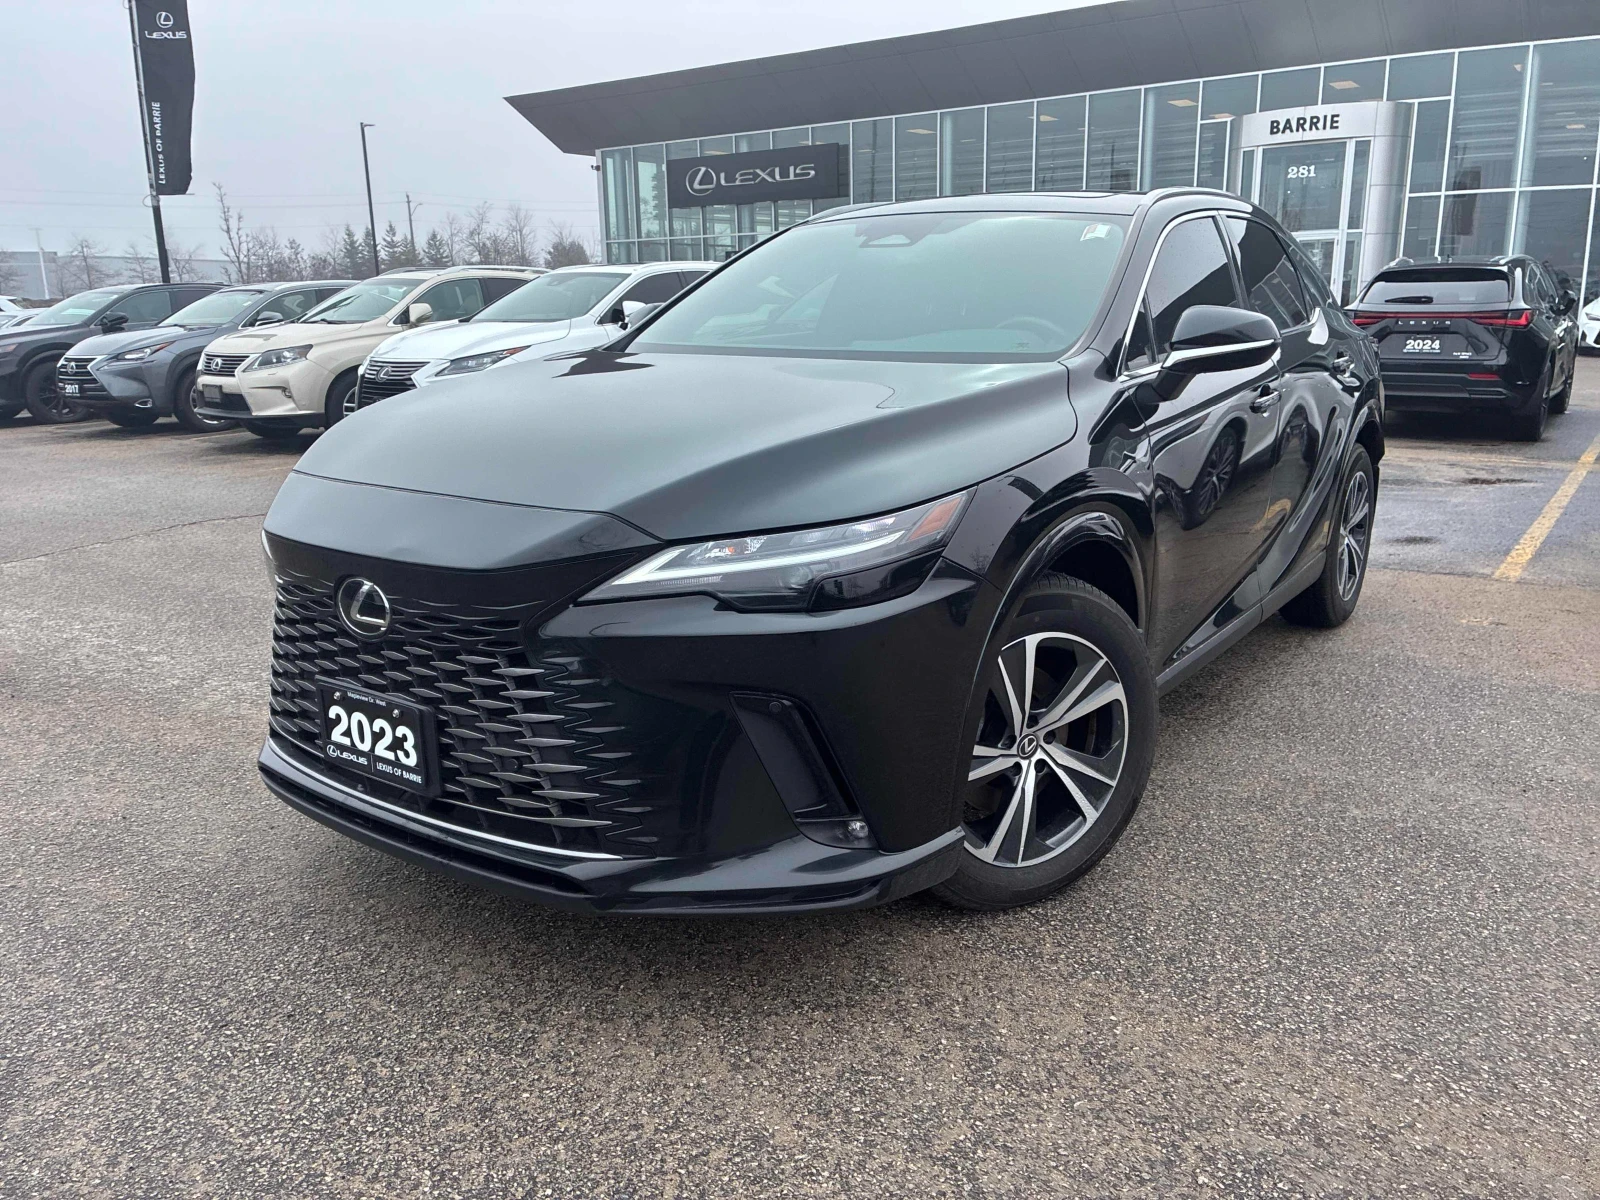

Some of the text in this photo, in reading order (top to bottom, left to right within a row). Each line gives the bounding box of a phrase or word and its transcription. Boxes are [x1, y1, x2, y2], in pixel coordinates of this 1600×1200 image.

[145, 30, 187, 39] LEXUS
[1269, 114, 1340, 135] BARRIE
[151, 101, 166, 184] LEXUS OF BARRIE
[720, 163, 816, 187] LEXUS
[1287, 165, 1316, 178] 281
[1405, 339, 1441, 350] 2024
[64, 384, 79, 393] 2017
[328, 705, 418, 767] 2023
[337, 750, 368, 765] LEXUS
[376, 761, 422, 784] LEXUS OF BARRIE
